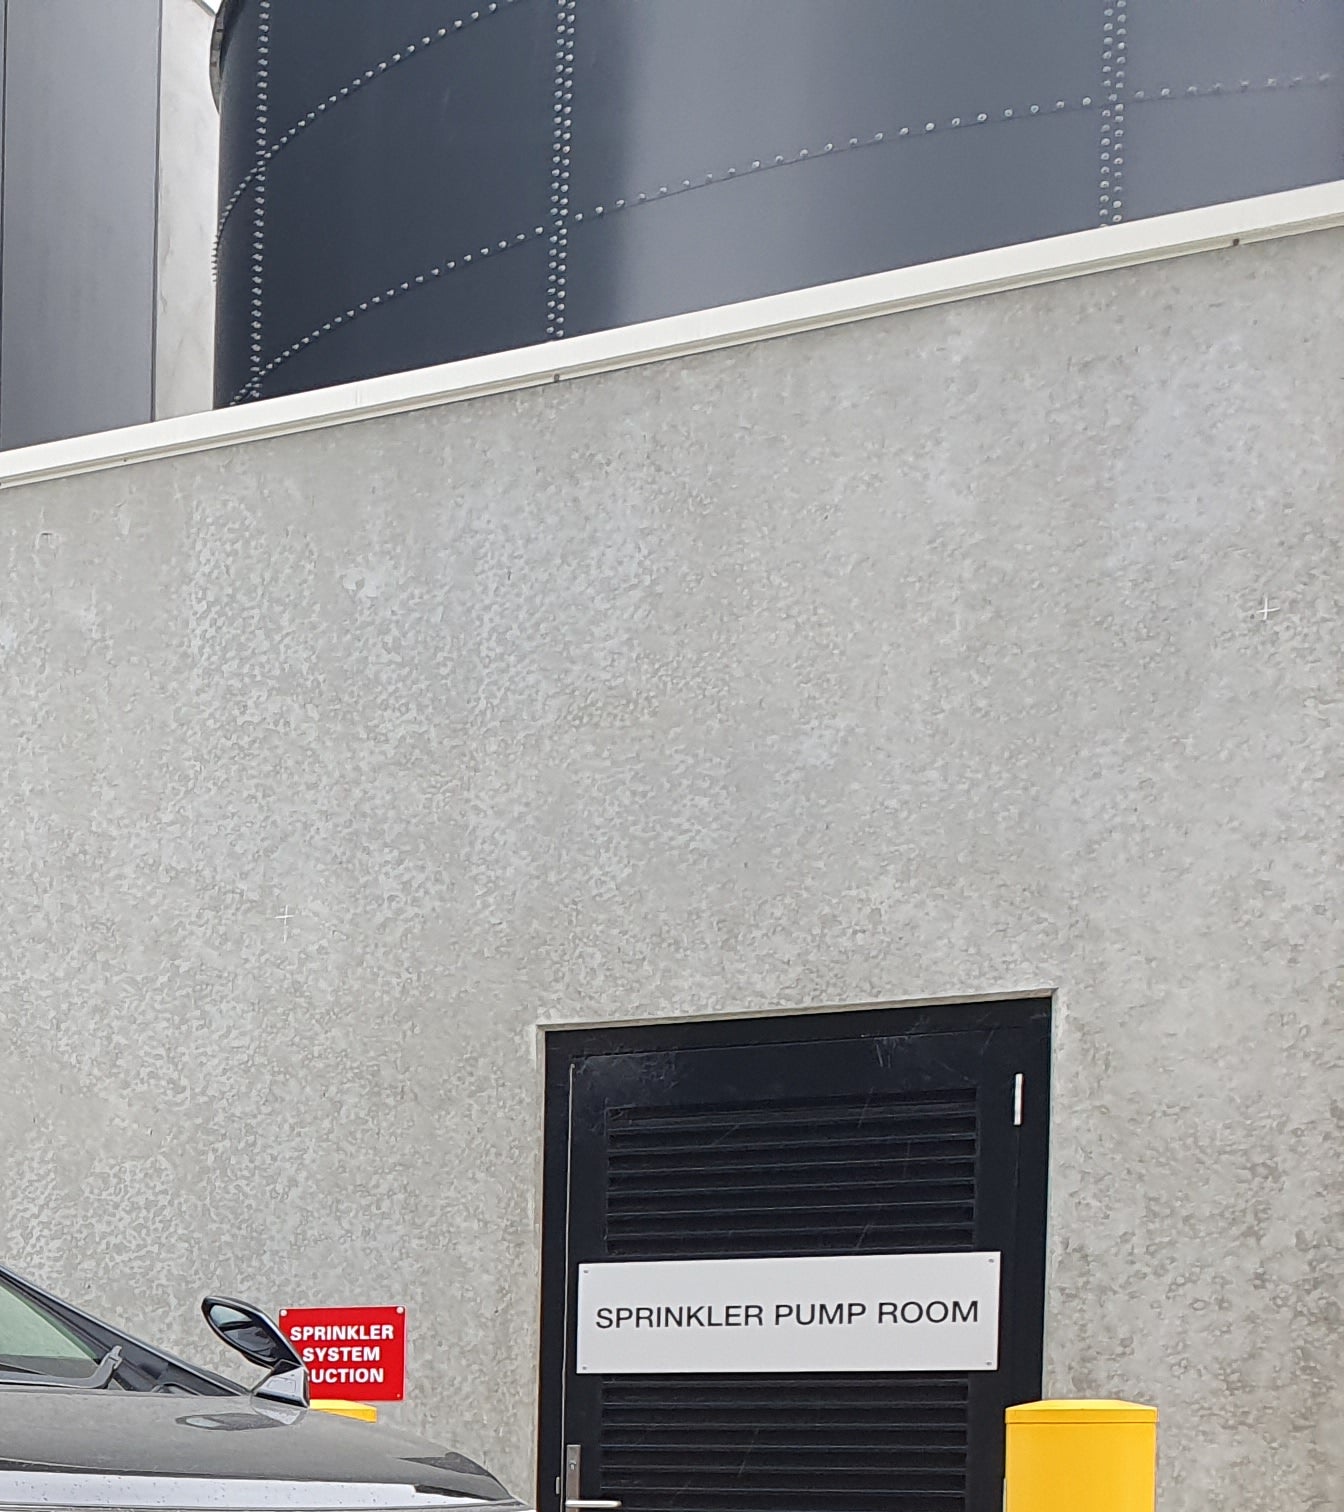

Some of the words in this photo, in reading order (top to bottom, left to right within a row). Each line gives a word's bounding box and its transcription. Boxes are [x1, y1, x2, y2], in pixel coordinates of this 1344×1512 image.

[595, 1304, 764, 1329] SPRINKLER
[775, 1303, 867, 1326] PUMP
[878, 1300, 979, 1325] ROOM
[289, 1325, 394, 1341] SPRINKLER
[302, 1347, 380, 1362] SYSTEM
[308, 1368, 384, 1384] UCTION
